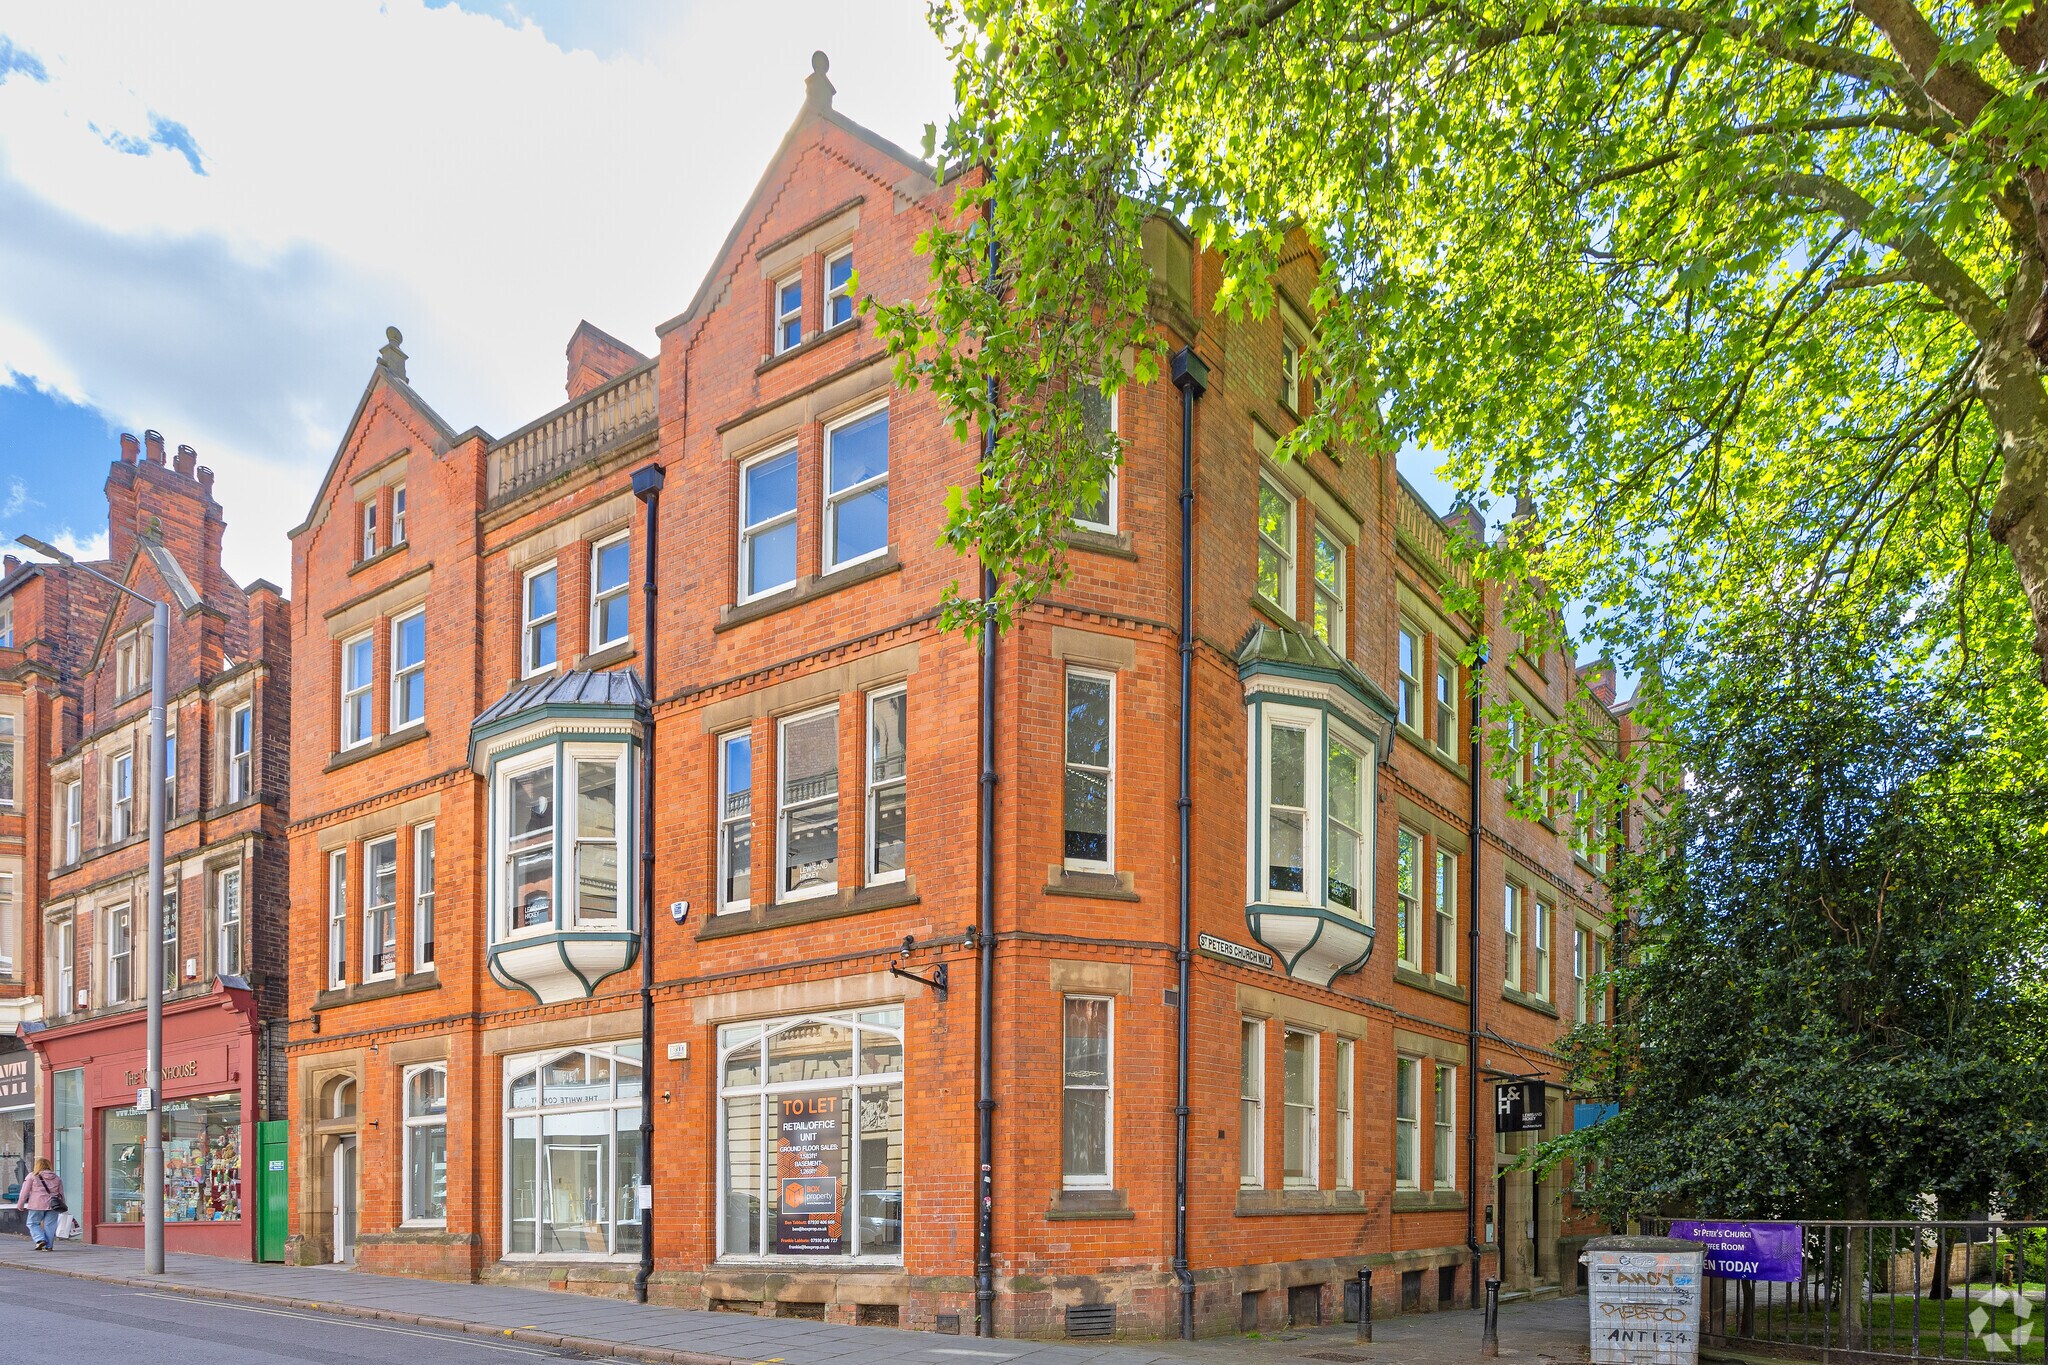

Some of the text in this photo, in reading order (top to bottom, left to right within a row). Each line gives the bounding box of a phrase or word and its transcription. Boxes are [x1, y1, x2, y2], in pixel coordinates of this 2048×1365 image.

[1208, 939, 1233, 955] PETERS
[1234, 946, 1257, 962] CHURCH
[1258, 952, 1272, 966] WALK
[124, 1060, 197, 1086] THE TNHOUSE
[783, 1097, 837, 1115] TO LET
[783, 1120, 835, 1131] RETAIL/OFFICE
[800, 1132, 817, 1141] UNIT
[779, 1145, 801, 1153] GROUND
[806, 1193, 833, 1201] property
[1724, 1229, 1752, 1239] CHURCH
[1706, 1242, 1745, 1251] FFEE ROOM
[1703, 1260, 1759, 1274] EN TODAY
